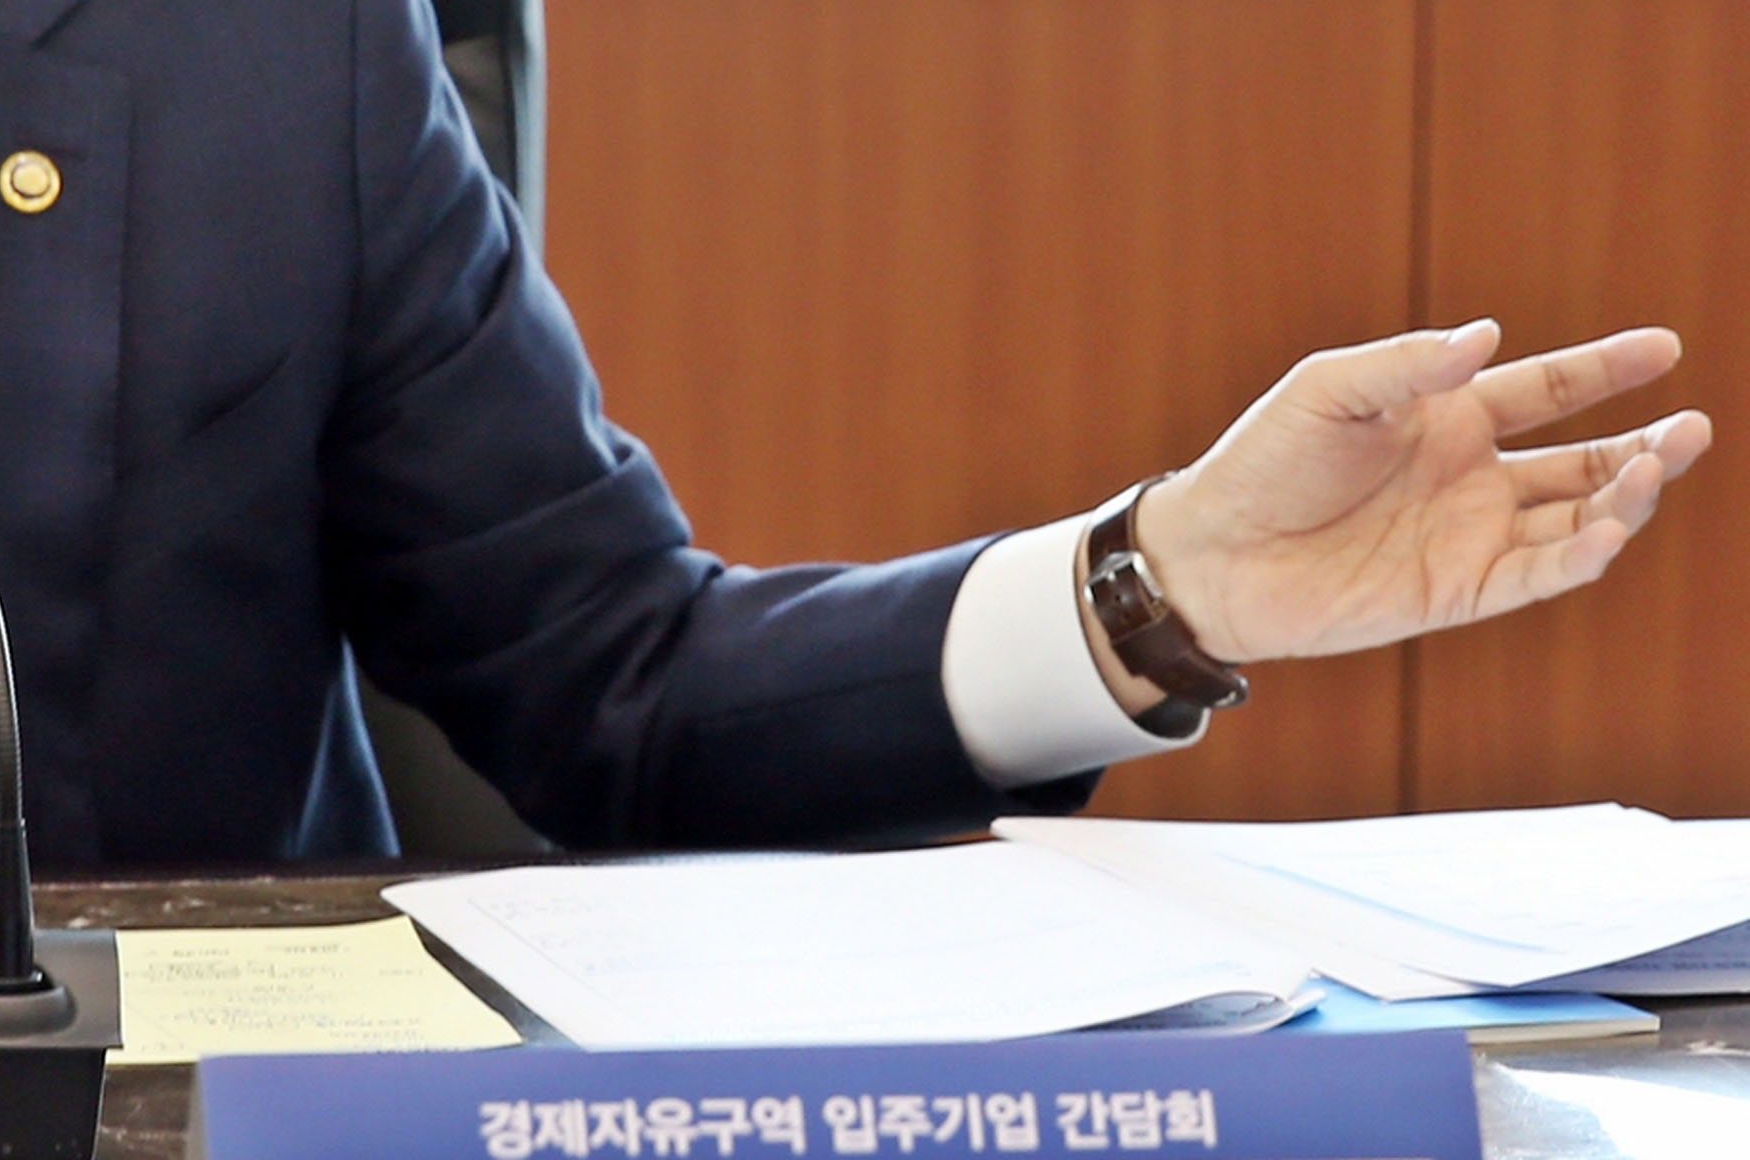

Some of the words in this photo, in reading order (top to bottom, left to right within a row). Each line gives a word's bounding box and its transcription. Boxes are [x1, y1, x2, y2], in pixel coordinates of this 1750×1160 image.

[479, 1096, 807, 1158] 경제자유구역
[822, 1091, 1040, 1153] 입주기업
[1056, 1089, 1217, 1149] 간담회
